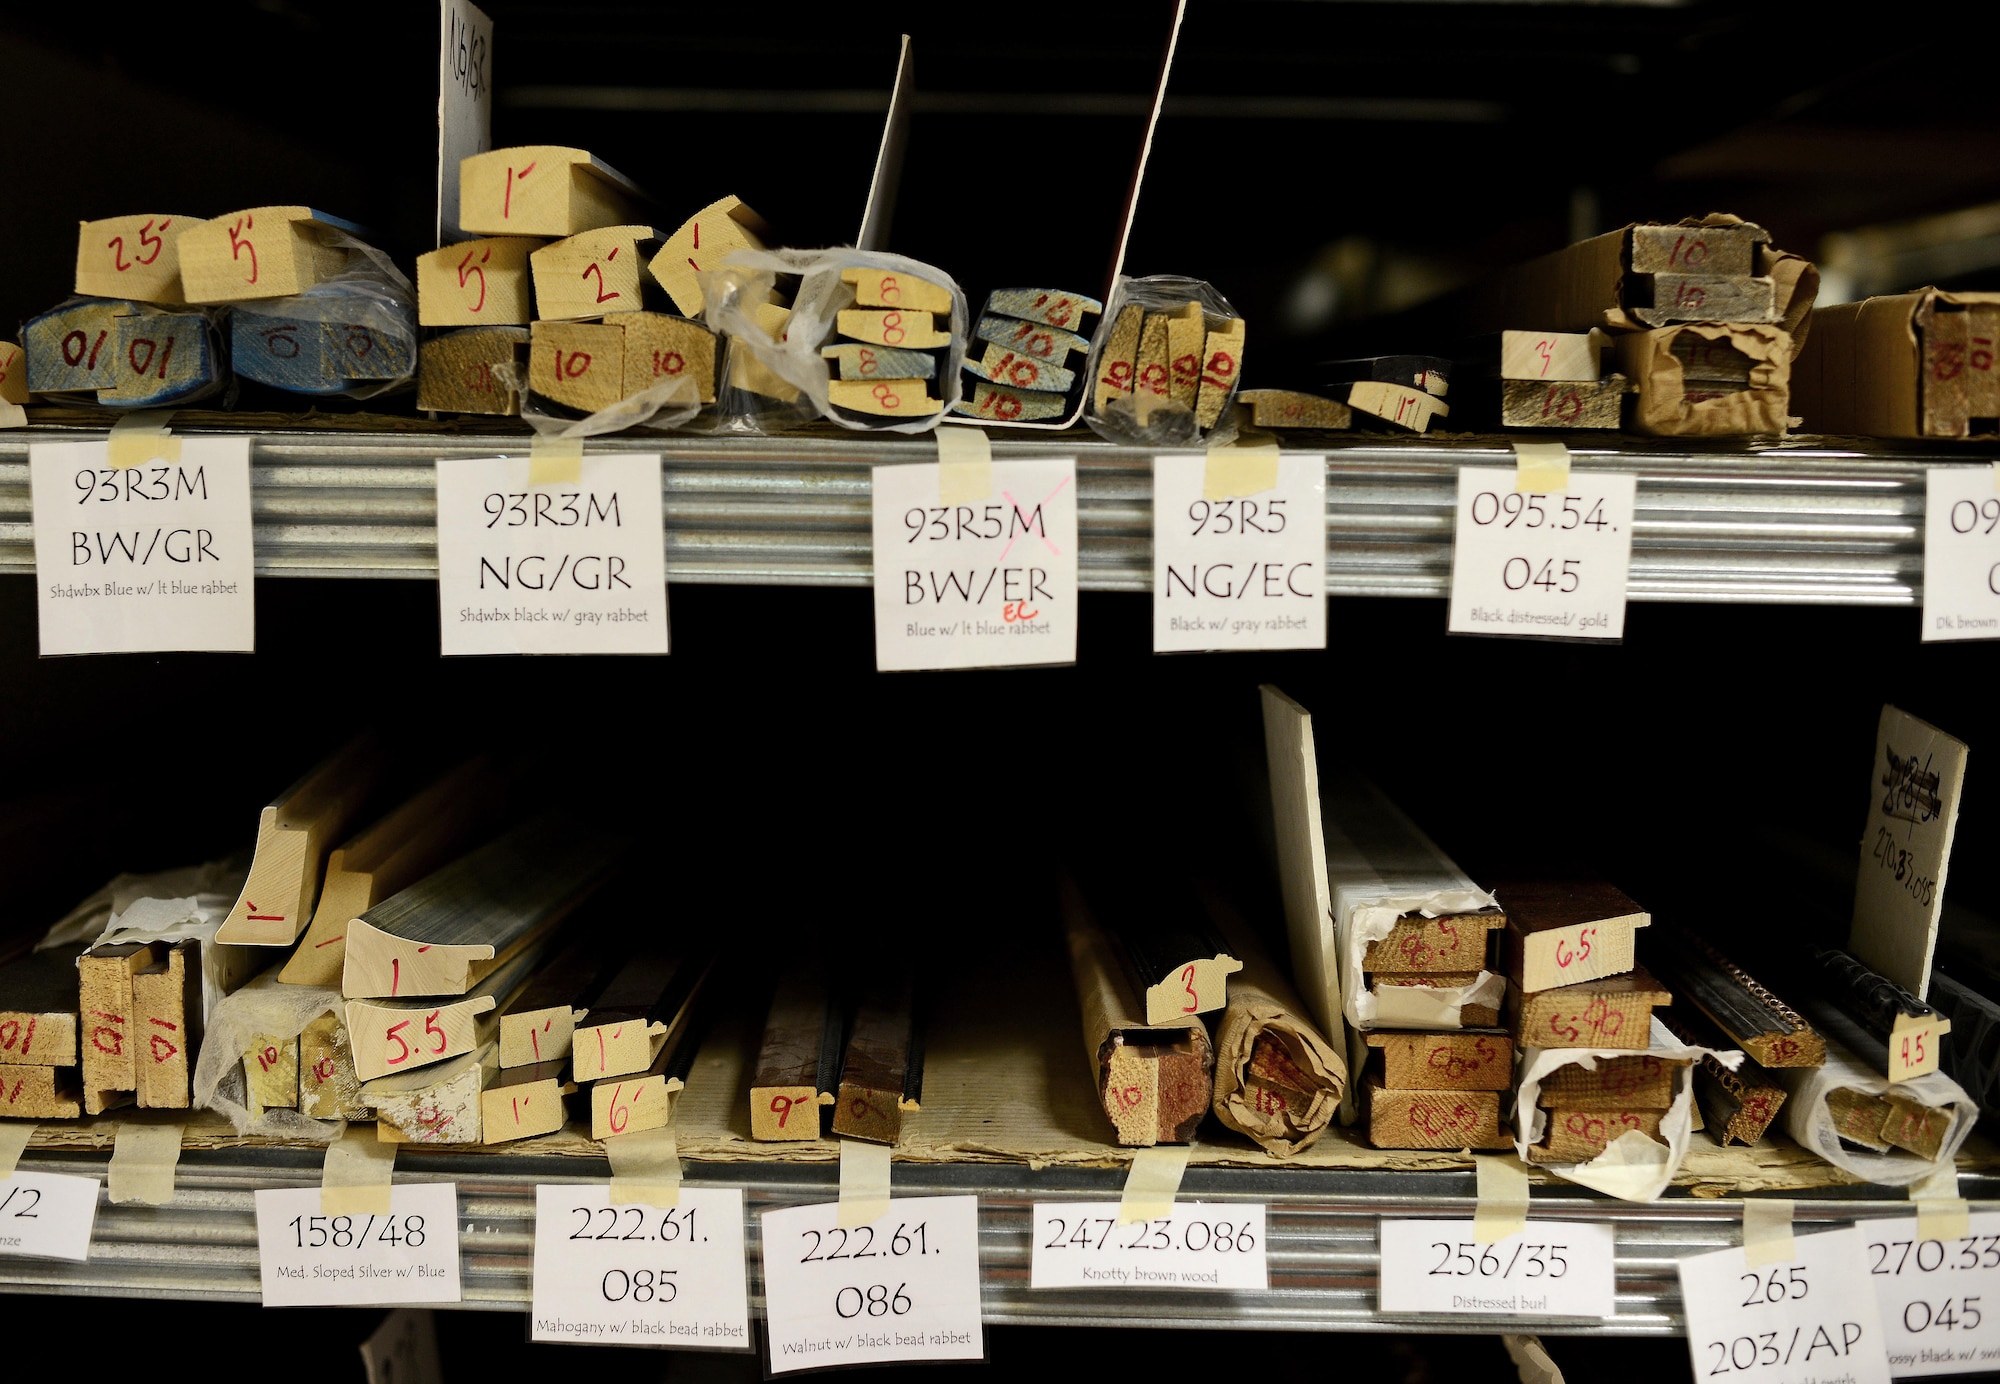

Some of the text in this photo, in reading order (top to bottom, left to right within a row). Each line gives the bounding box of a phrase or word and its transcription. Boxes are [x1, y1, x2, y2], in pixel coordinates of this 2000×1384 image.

[1669, 236, 1708, 267] 10
[883, 312, 905, 346] 8
[1014, 324, 1054, 358] 10
[555, 350, 592, 381] 10
[653, 350, 686, 378] 10
[990, 352, 1039, 388] 10
[873, 384, 900, 409] 8
[980, 391, 1023, 421] 10
[1541, 387, 1583, 423] 10
[76, 466, 207, 504] 93R3M
[484, 492, 620, 528] 93R3M
[905, 504, 1045, 543] 93R5M
[1189, 500, 1286, 536] 93R5
[73, 529, 219, 565] BW/GR
[480, 555, 631, 591] NG/GR
[906, 568, 1053, 606] BW/ER
[1167, 563, 1312, 599] NG/EC
[51, 580, 237, 598] Shdwbx Blue w/ lt blue rabbet
[460, 607, 648, 625] Shdwbx black w/ gray rabbet
[1003, 600, 1039, 622] EC
[1171, 616, 1307, 635] Black w/ gray rabbet
[1471, 607, 1503, 622] Black
[1579, 613, 1608, 630] gold
[1957, 615, 1998, 629] brown
[907, 619, 1049, 636] Blue w/ lt blue rabbet
[1181, 964, 1199, 1013] 3
[387, 1010, 448, 1065] 5.5
[257, 1046, 278, 1073] 10
[312, 1057, 335, 1084] 10
[1112, 1086, 1143, 1118] 10
[289, 1215, 425, 1249] 158/48
[1045, 1218, 1254, 1252] 247.23.086
[277, 1264, 445, 1281] Med. Sloped Silver w/ Blue
[1083, 1266, 1217, 1286] Knotty brown wood
[1429, 1243, 1567, 1278] 256/35
[1741, 1266, 1808, 1307] 265
[1451, 1295, 1546, 1312] Distressed burl
[537, 1318, 743, 1337] Mahogany w/ black bead rabbet
[783, 1331, 970, 1355] Walnut w/ black bead rabbet
[1709, 1323, 1862, 1378] 203/AP
[1921, 1348, 1955, 1363] black
